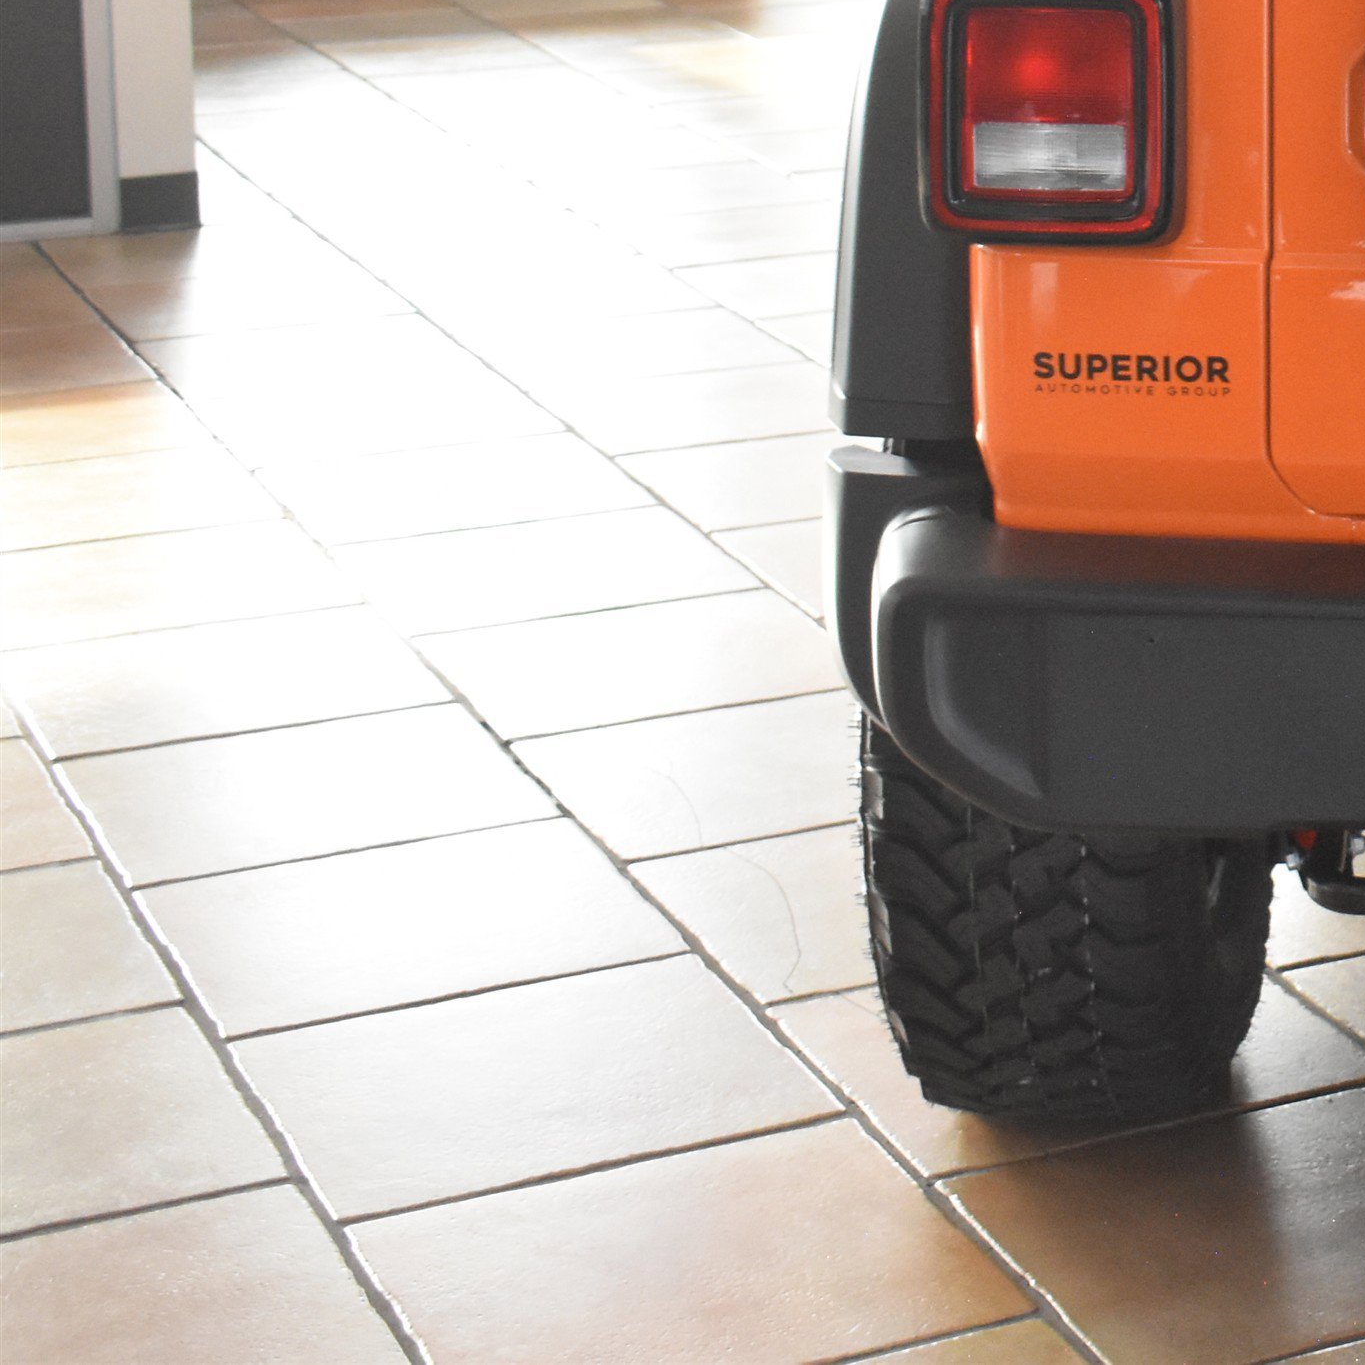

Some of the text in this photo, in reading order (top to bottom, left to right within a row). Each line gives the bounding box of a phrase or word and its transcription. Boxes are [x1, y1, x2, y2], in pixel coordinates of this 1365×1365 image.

[1034, 352, 1230, 383] SUPERIOR
[1035, 384, 1231, 397] AUTOMOTIVE GROUP
